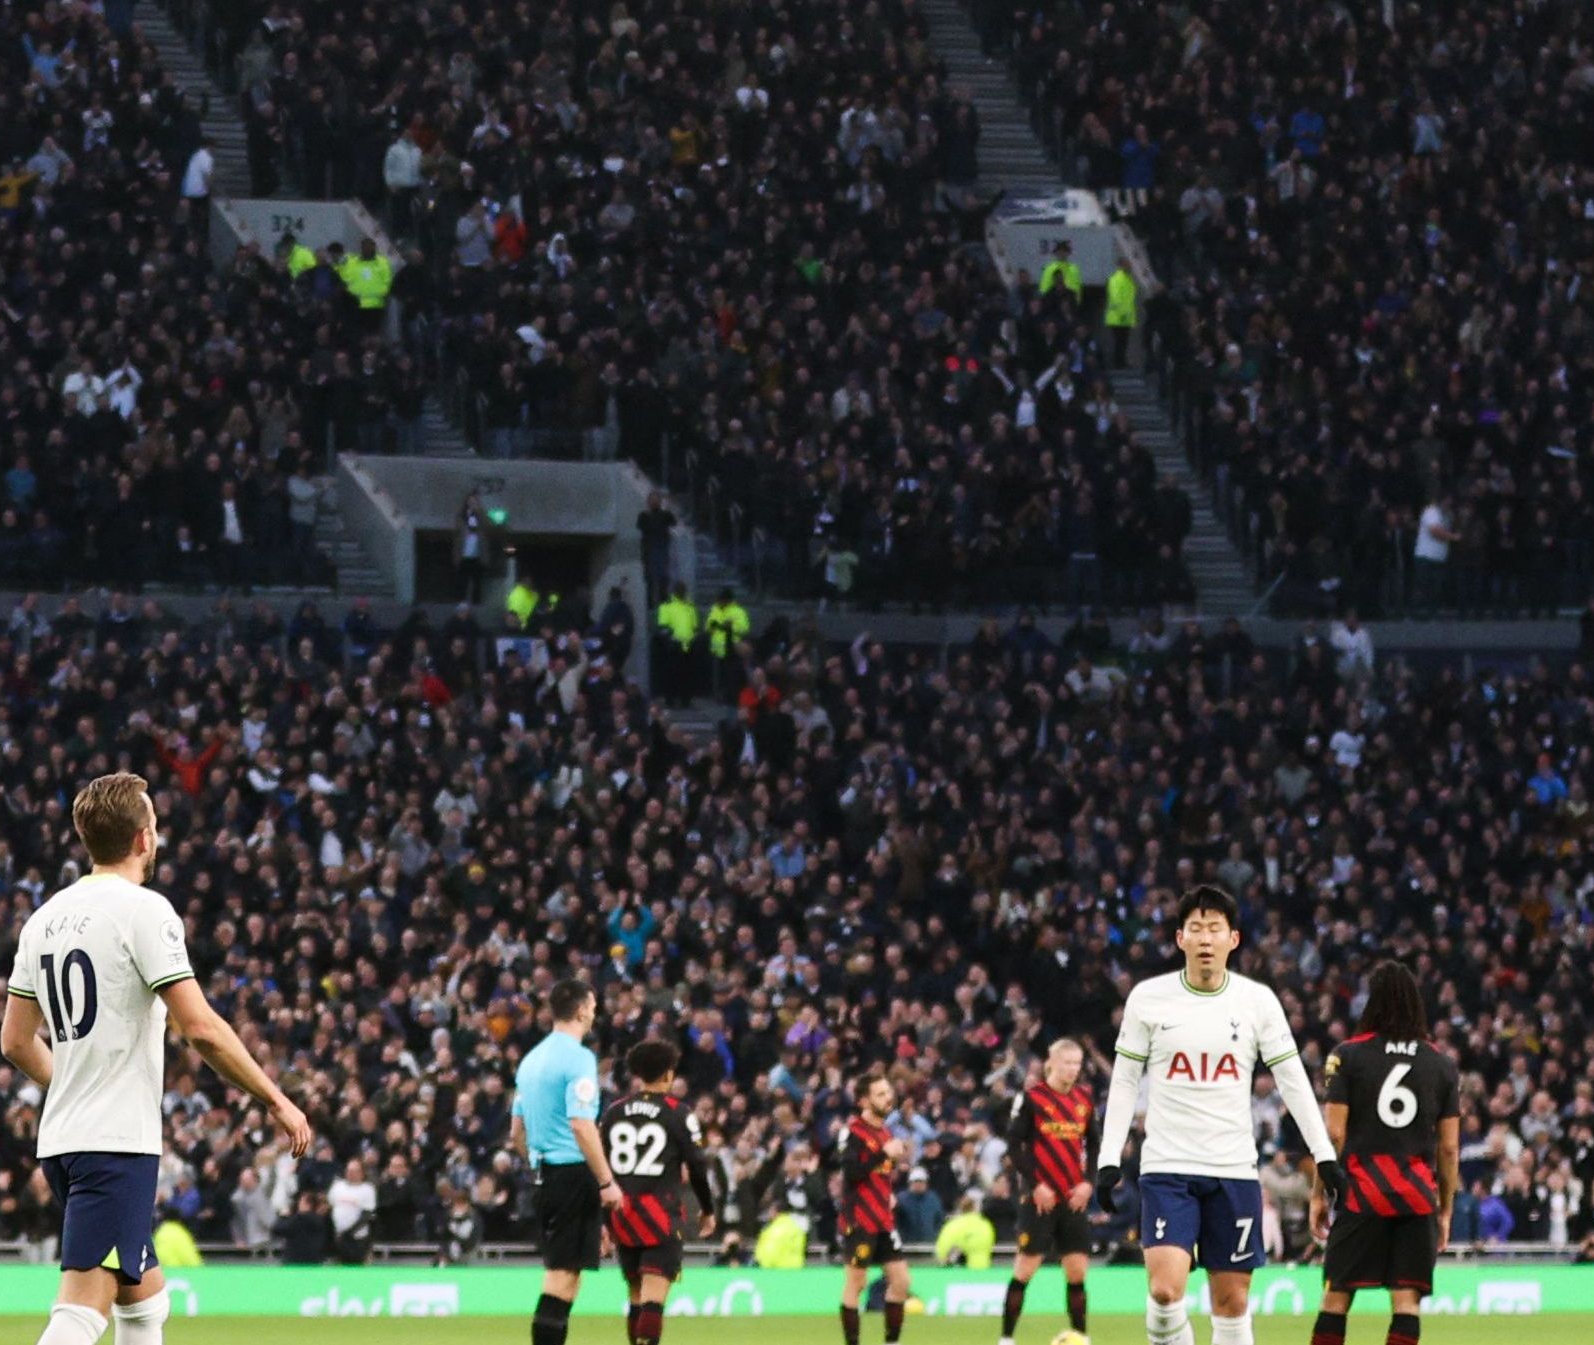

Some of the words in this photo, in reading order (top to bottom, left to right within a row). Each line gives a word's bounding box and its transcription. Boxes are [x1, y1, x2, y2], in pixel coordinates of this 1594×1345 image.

[40, 949, 98, 1043] 10
[1166, 1052, 1240, 1082] AIA
[624, 1101, 661, 1119] LEWIS
[1377, 1063, 1419, 1129] 6
[609, 1121, 667, 1176] 82
[1233, 1218, 1254, 1252] 7
